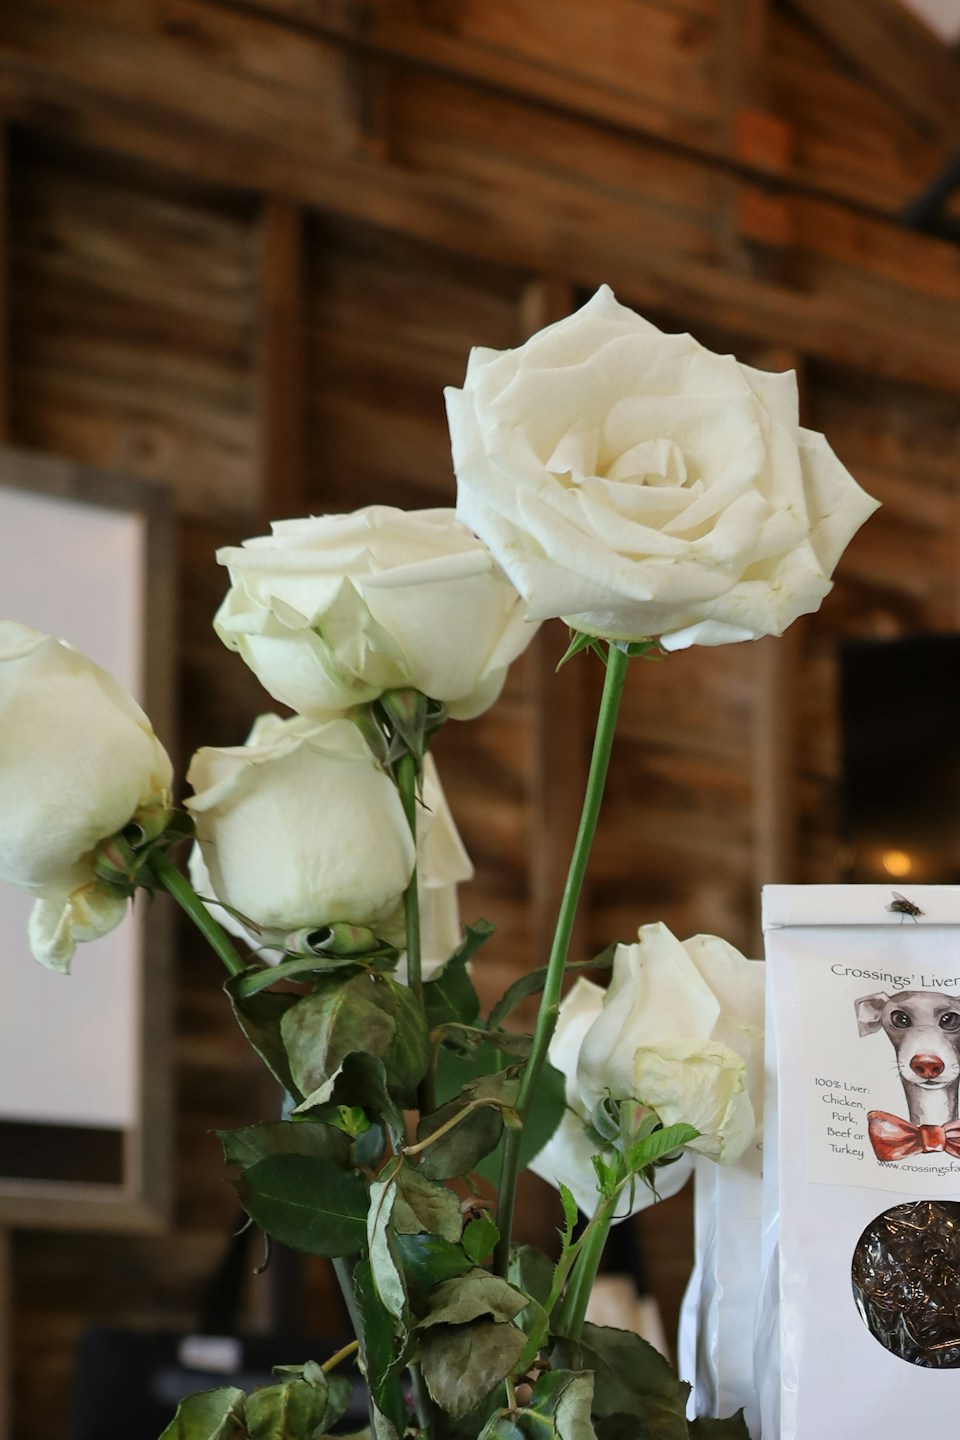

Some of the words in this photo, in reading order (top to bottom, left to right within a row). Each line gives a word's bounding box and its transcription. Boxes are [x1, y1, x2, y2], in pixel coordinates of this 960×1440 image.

[830, 963, 915, 990] Crossings'
[920, 974, 960, 988] Liver
[814, 1077, 841, 1089] 100%
[844, 1082, 871, 1095] Liver:
[821, 1093, 866, 1111] Chicken,
[831, 1111, 858, 1125] Pork,
[826, 1126, 851, 1139] Beef
[853, 1131, 865, 1141] or
[829, 1143, 865, 1161] Turkey
